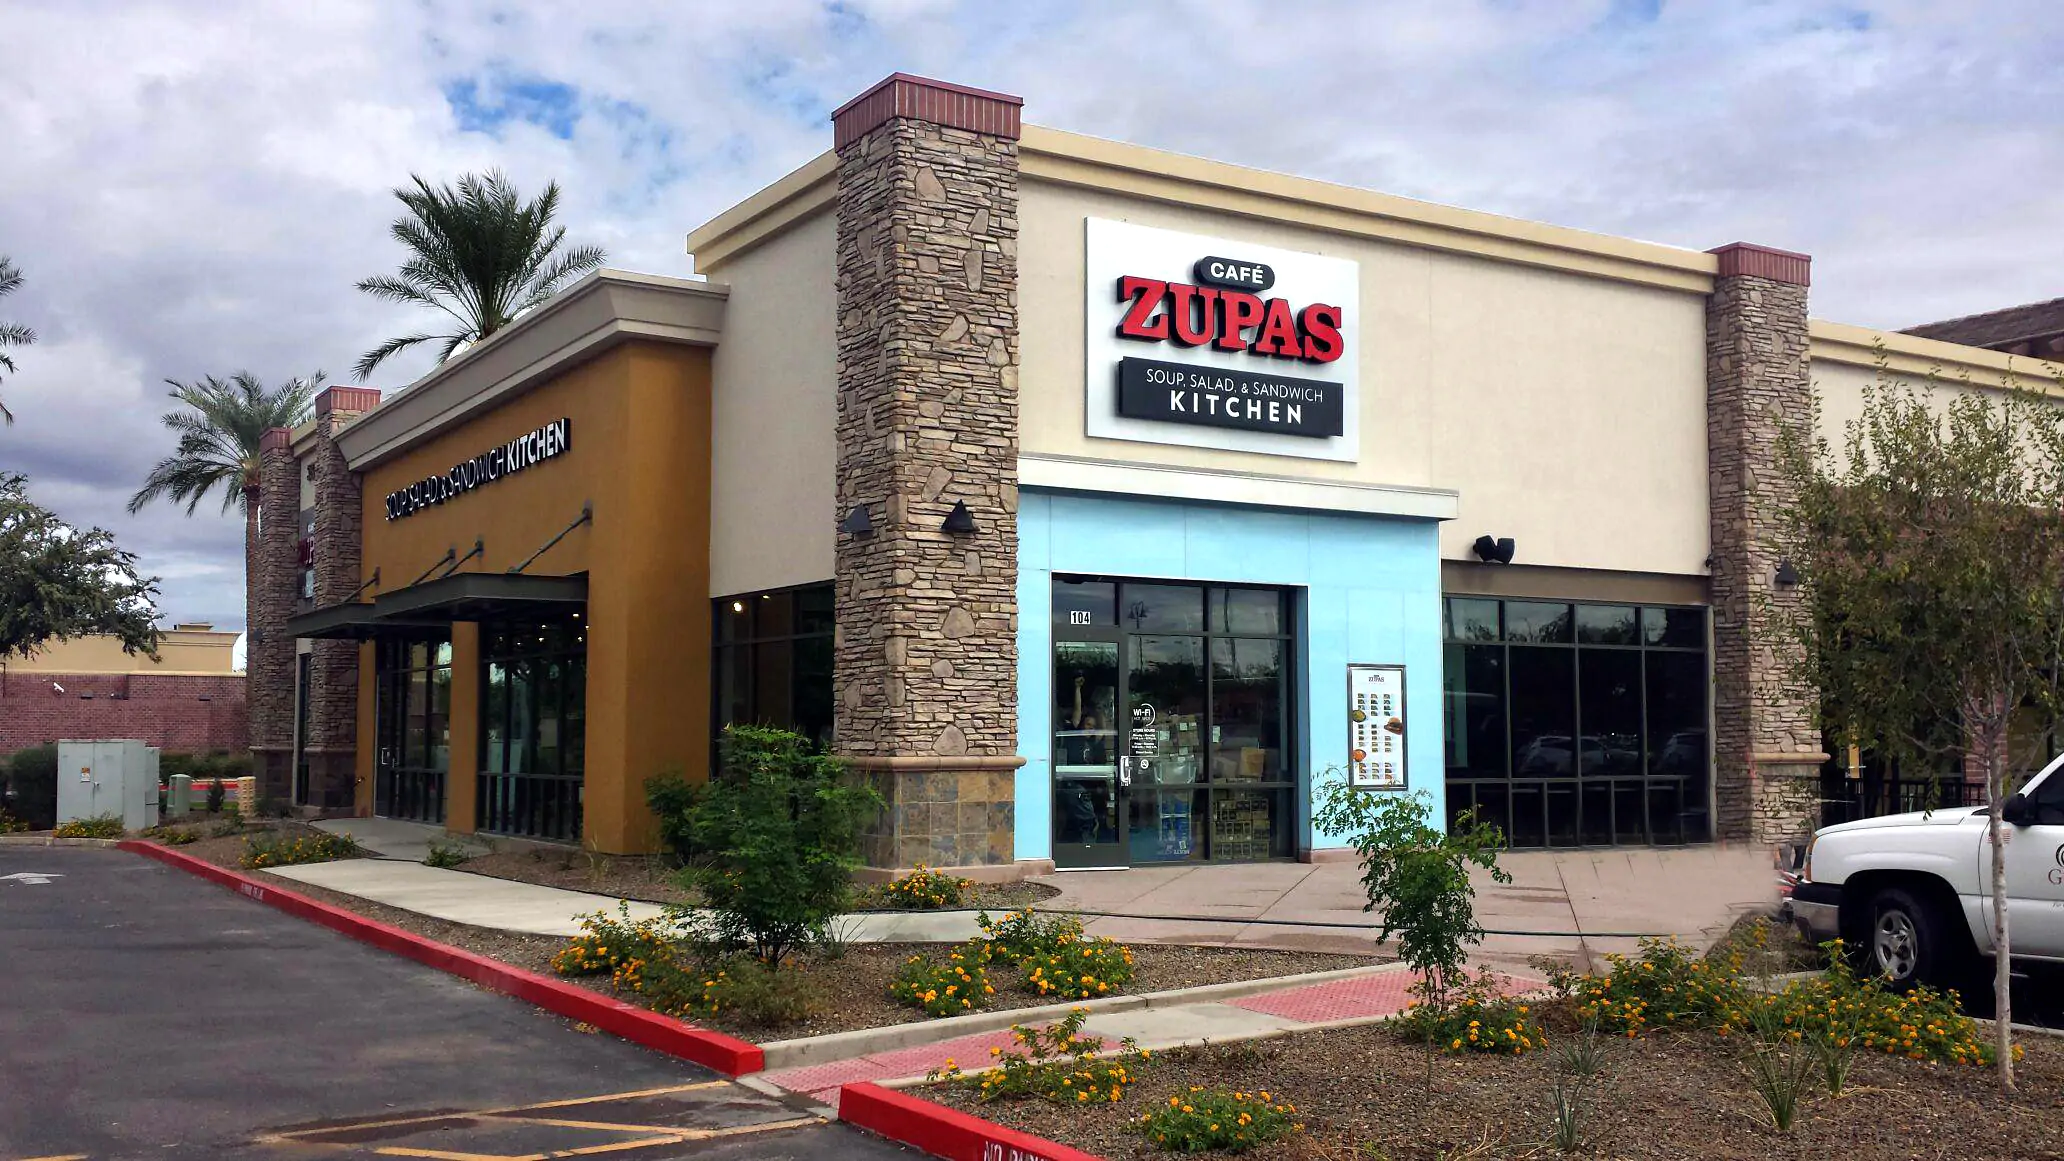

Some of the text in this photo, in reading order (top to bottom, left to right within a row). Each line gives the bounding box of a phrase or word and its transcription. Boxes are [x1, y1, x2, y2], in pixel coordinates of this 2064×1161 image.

[1210, 262, 1264, 284] CAFÉ
[1118, 275, 1344, 363] ZUPAS
[1146, 368, 1323, 403] SOUP, SALAD, & SANDWICH
[1170, 389, 1302, 425] KITCHEN
[448, 447, 504, 497] SANDWICH
[507, 418, 565, 473] KITCHEN
[1072, 612, 1089, 623] 104
